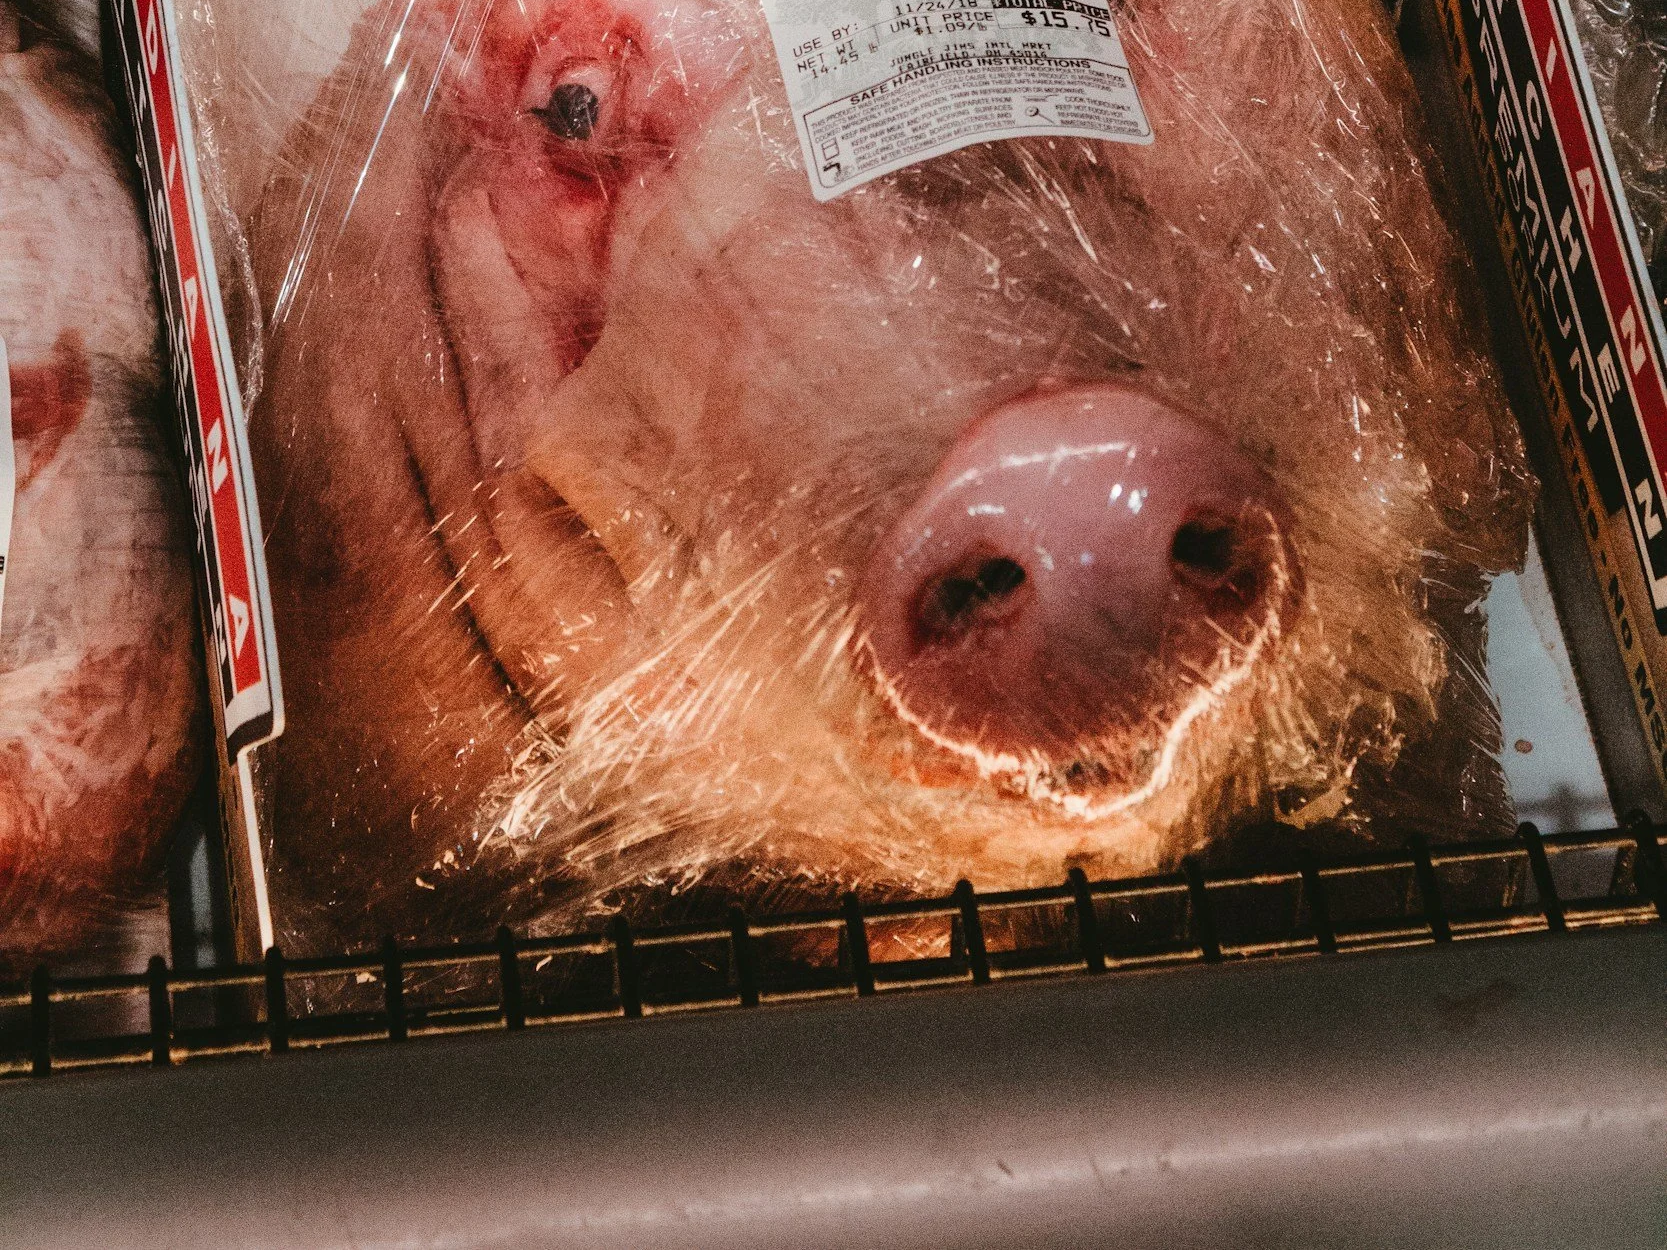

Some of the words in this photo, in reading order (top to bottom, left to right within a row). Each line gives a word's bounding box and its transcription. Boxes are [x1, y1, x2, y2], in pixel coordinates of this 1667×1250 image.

[889, 15, 931, 33] UNIT
[942, 10, 996, 23] PRICE
[1021, 9, 1112, 38] $15.75
[1061, 0, 1112, 20] PRICE
[793, 37, 823, 58] USE
[831, 22, 860, 41] BY:
[797, 53, 825, 73] NET
[836, 39, 855, 56] WT
[811, 50, 859, 79] 14.45
[849, 83, 890, 106] SAFE
[892, 58, 973, 88] HANDLING
[976, 57, 1092, 69] INSTRUCTIONS
[1495, 120, 1549, 309] PORK
[1557, 424, 1603, 539] Free
[1608, 574, 1633, 651] No
